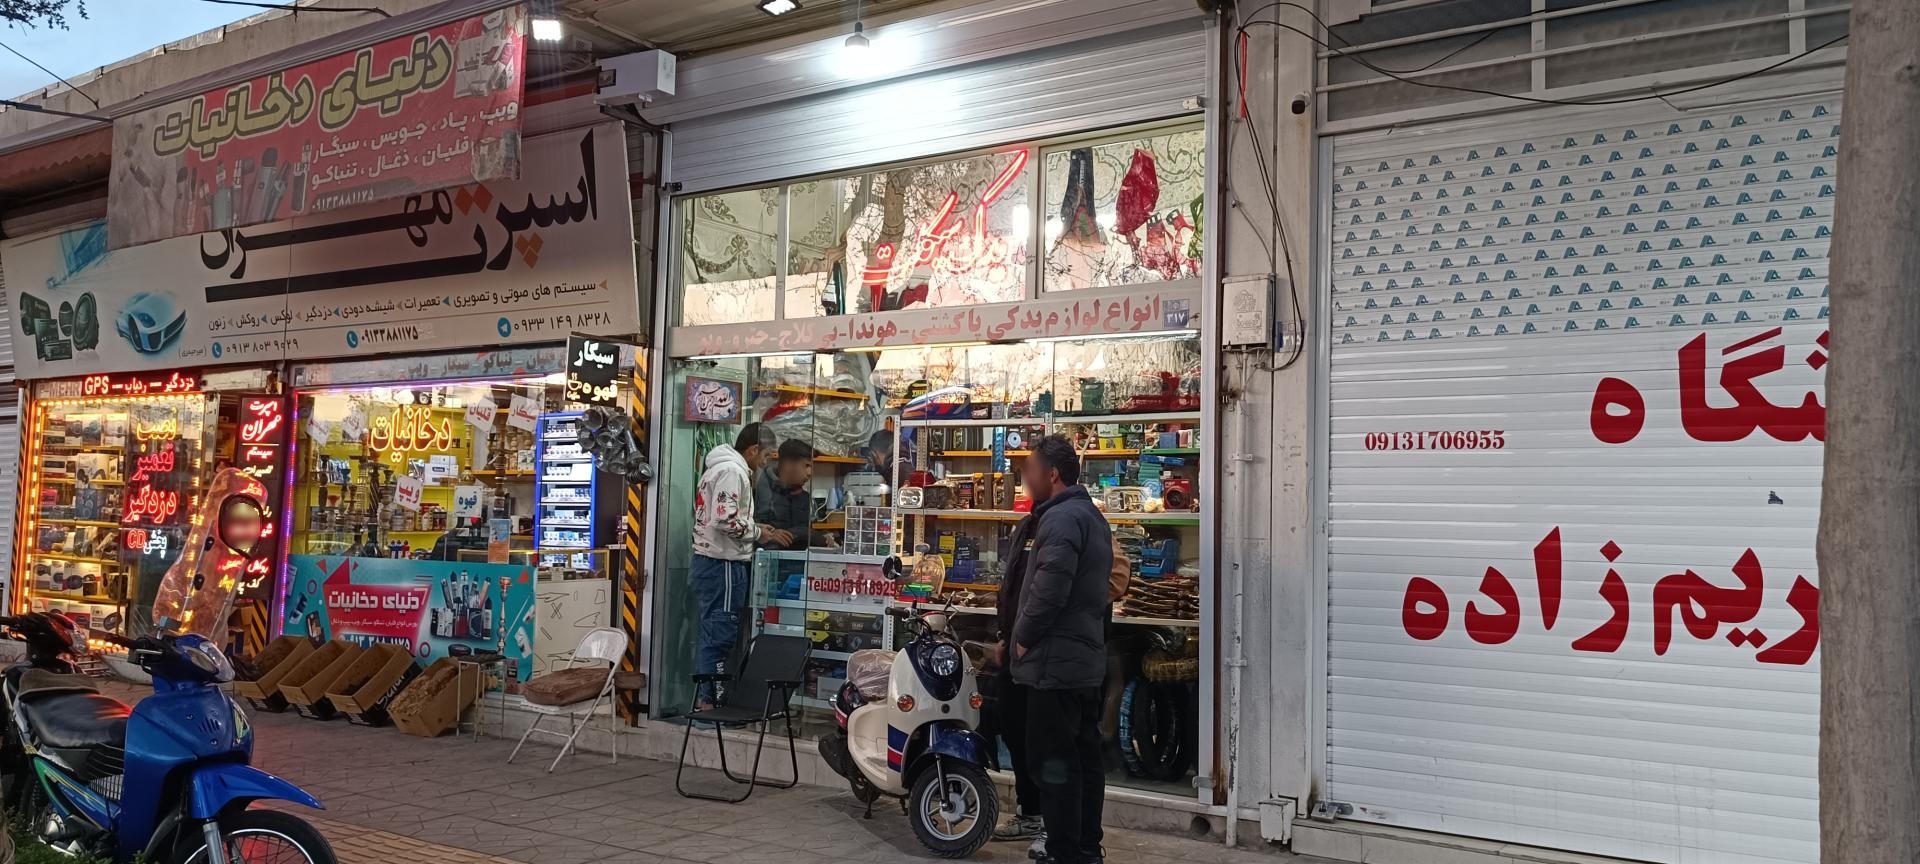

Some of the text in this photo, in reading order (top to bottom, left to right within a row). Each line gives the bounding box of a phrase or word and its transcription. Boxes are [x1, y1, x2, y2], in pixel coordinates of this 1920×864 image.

[153, 32, 454, 161] دنیای دخانیات
[440, 111, 468, 133] پاد
[480, 101, 518, 126] ویپ
[371, 121, 428, 149] جویس
[312, 136, 471, 190] قلیان ذغال تنباکو
[208, 282, 597, 331] سیستم های صوتی و تصویری تعمیرات شیشه دودی دزدگیر لوکس روکش زنون
[1045, 298, 1101, 337] لوازم
[1103, 293, 1160, 332] انواع
[1166, 311, 1185, 324] ۳۱۷
[361, 325, 419, 344] ۰۹۱۳۳۸۸۱۱۷۵
[514, 311, 611, 332] ۰۹۳۳ ۱۴۹ ۸۳۲۸
[848, 316, 897, 346] هوندا
[986, 305, 1042, 342] یدکی
[226, 342, 250, 354] ۰۹۱۳
[815, 325, 837, 351] بی
[84, 373, 195, 395] دزدگیر ردیاب GPS
[582, 379, 618, 402] قهوه
[136, 406, 177, 453] نصب
[241, 414, 282, 442] مهران
[369, 406, 452, 463] دخانیات
[1365, 431, 1505, 450] 09131706955
[132, 442, 175, 481] تعمیر
[123, 484, 177, 524] دزدگیر
[398, 486, 420, 504] ویپ
[458, 490, 478, 510] قهوه
[127, 528, 168, 559] پخش CD
[328, 590, 420, 614] دنیای دخانیات
[1401, 526, 1630, 653] زاده
